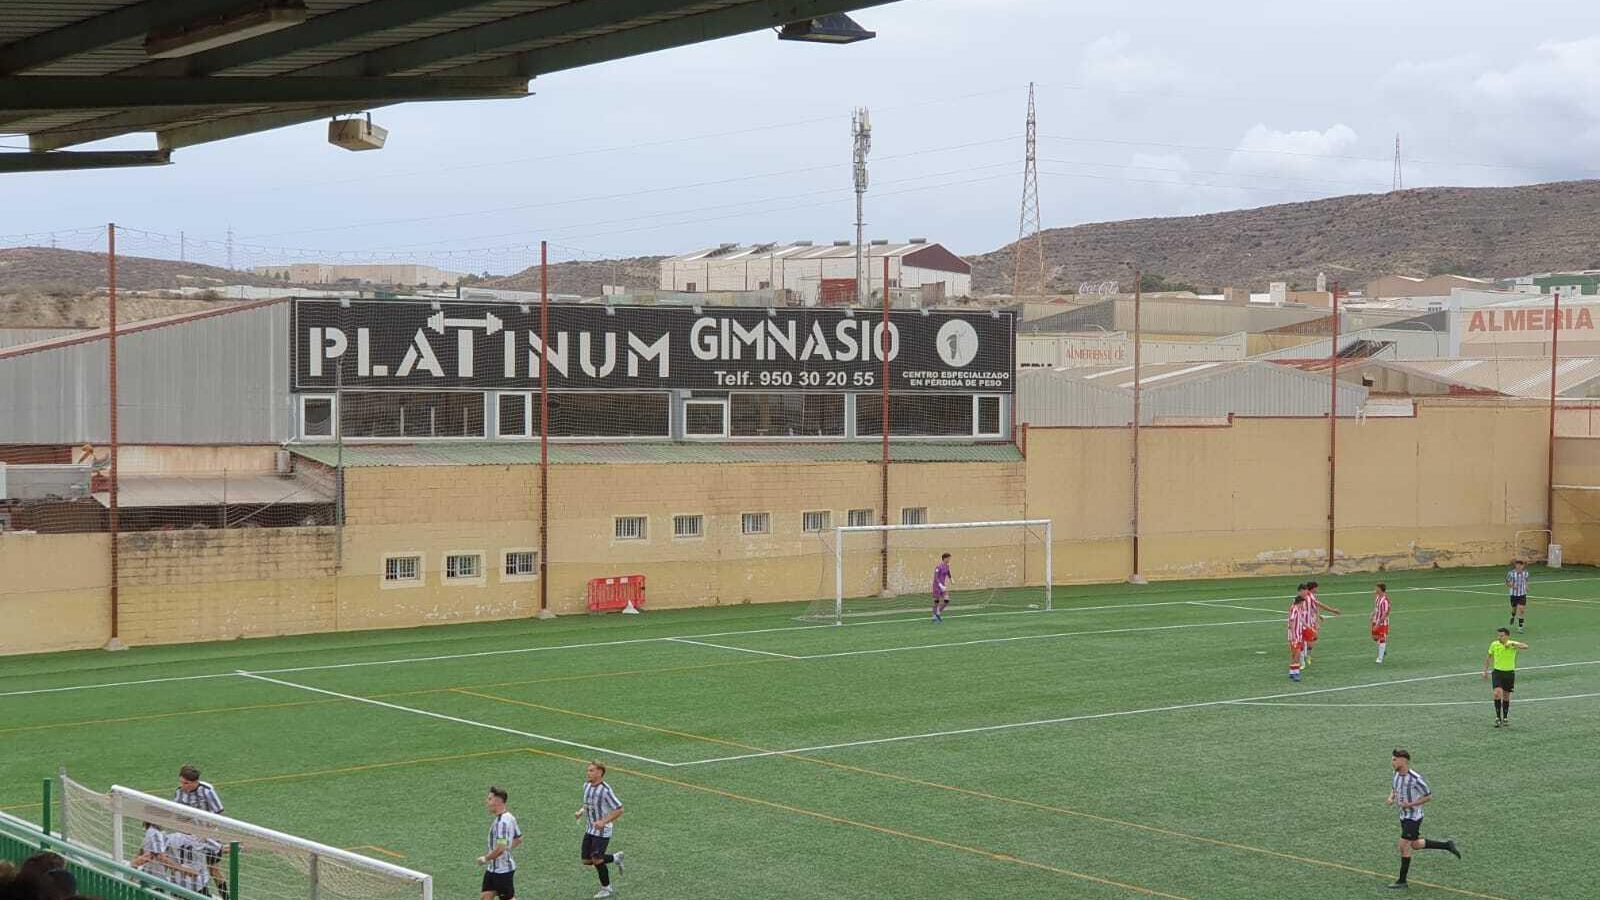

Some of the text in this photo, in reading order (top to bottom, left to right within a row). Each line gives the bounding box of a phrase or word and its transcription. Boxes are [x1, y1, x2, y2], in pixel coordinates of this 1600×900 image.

[309, 314, 670, 378] PLATINUM
[690, 317, 899, 361] GIMNASIO
[714, 371, 874, 386] Telf. 950 30 20 55
[902, 371, 1010, 379] CENTRO ESPECIALIZADO
[965, 379, 977, 387] DE
[979, 379, 1002, 387] PESO
